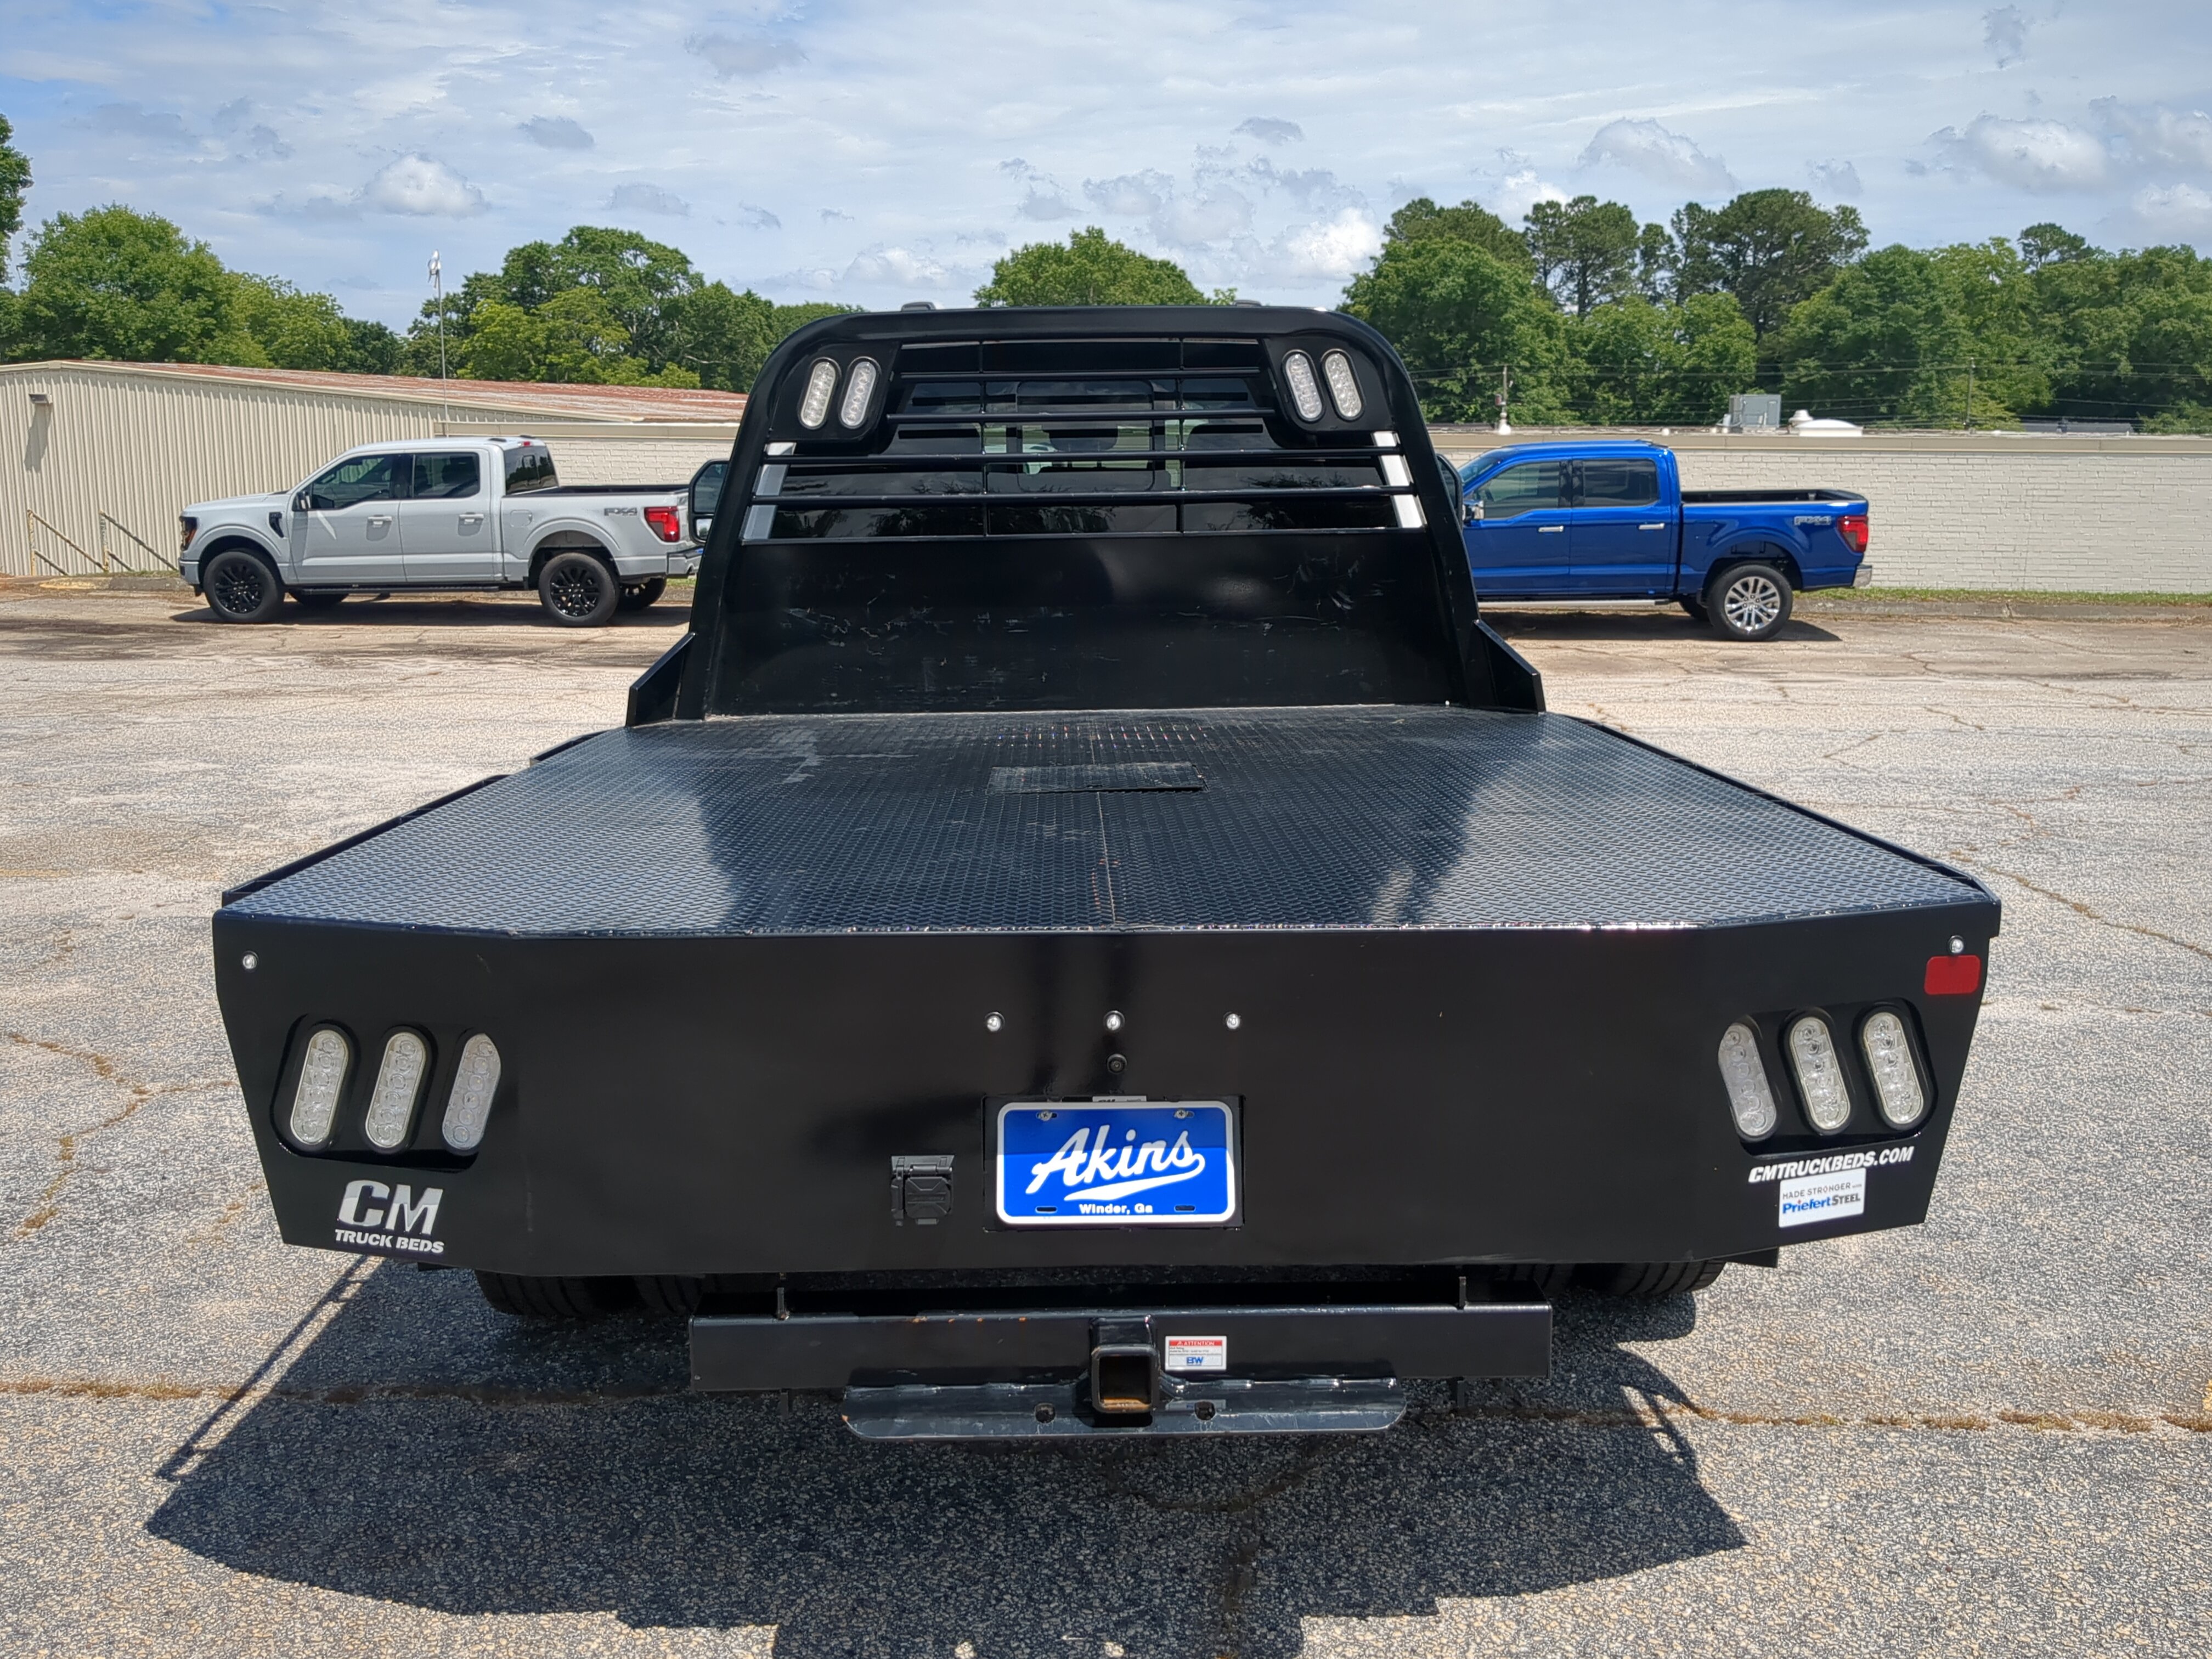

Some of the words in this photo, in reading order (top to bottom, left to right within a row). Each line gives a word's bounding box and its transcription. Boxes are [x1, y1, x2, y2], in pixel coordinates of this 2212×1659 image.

[604, 507, 637, 516] FX4
[1794, 516, 1832, 525] FX4
[1025, 1125, 1203, 1194] Akins
[1748, 1146, 1915, 1183] CMTRUCKBEDS.COM
[1782, 1189, 1805, 1199] MADE
[1807, 1182, 1851, 1195] STRONGER
[338, 1180, 443, 1234] CM
[1079, 1204, 1130, 1214] Winder,
[1135, 1203, 1153, 1214] Ga
[335, 1229, 393, 1248] TRUCK
[395, 1236, 445, 1254] BEDS
